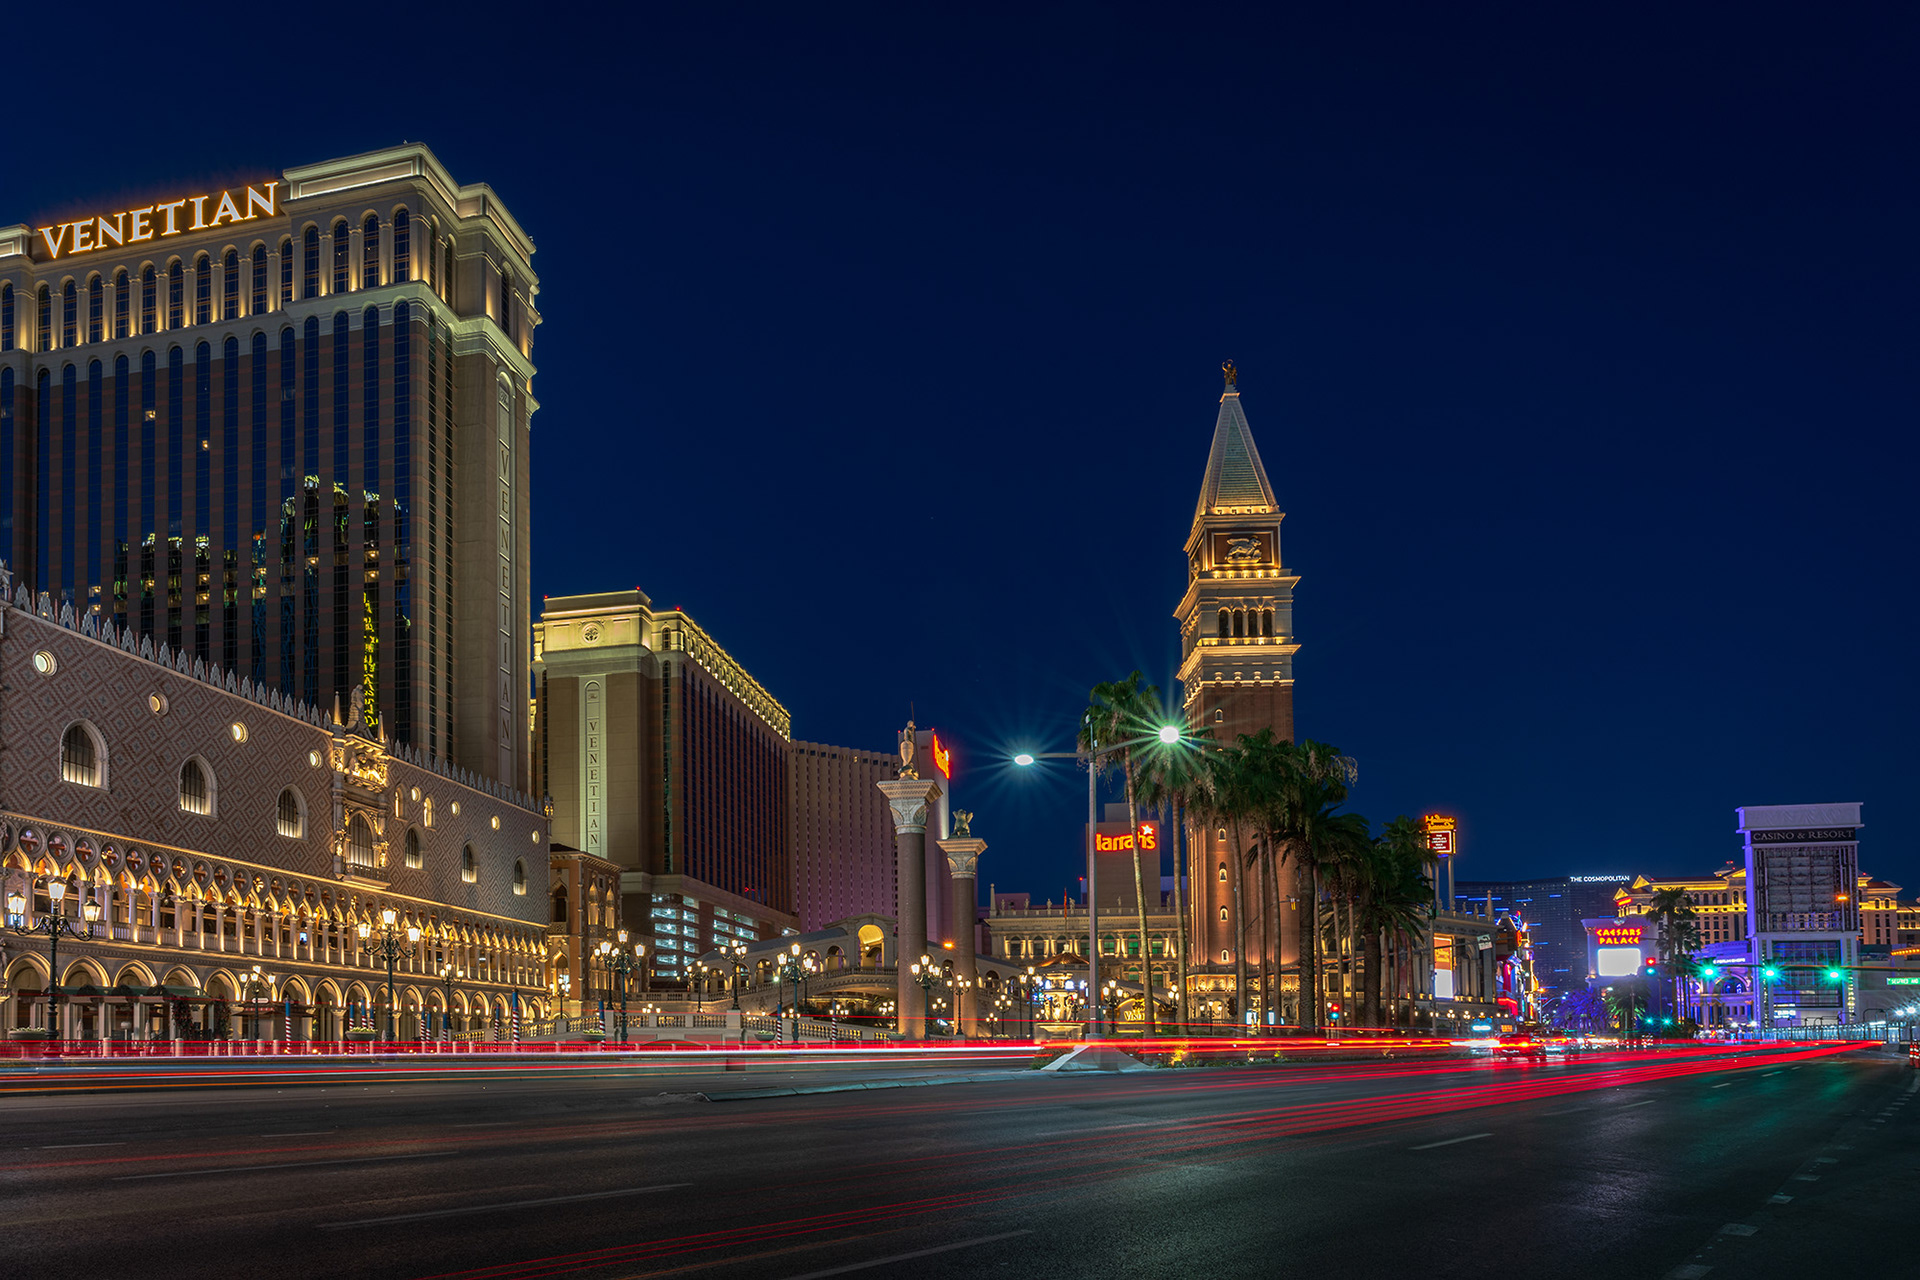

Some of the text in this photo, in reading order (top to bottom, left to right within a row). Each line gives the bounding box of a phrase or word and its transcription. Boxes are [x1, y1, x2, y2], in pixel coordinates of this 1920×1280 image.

[38, 181, 279, 259] VENETIAN
[501, 447, 510, 740] VENETIAN
[589, 721, 598, 845] VENETIAN
[1753, 832, 1794, 840] CASINO
[1808, 830, 1854, 839] RESORT
[1596, 928, 1642, 936] CAESARS
[1599, 936, 1640, 945] PALACE
